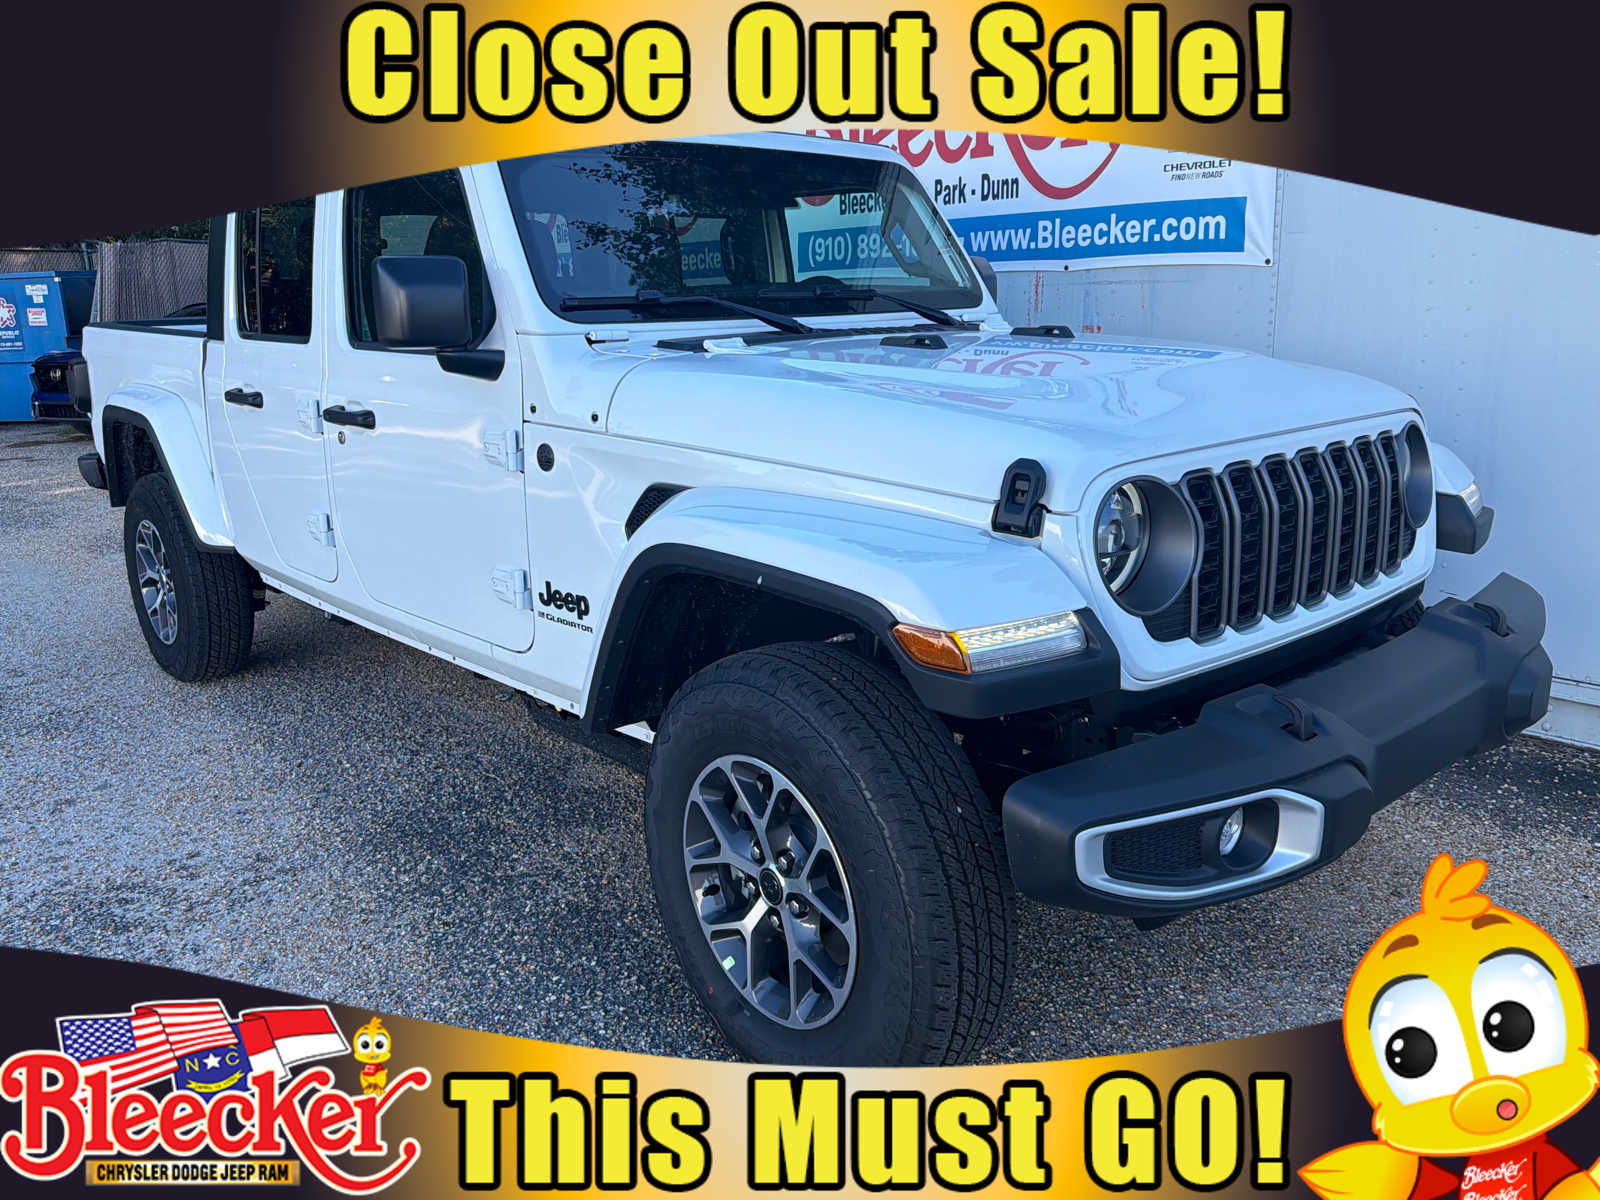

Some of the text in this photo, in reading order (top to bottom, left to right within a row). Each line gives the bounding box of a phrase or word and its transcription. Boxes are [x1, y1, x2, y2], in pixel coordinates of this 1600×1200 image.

[1163, 159, 1232, 173] CHEVROLET
[934, 176, 967, 205] Park
[981, 173, 1019, 202] Dunn
[808, 232, 852, 267] (910)
[970, 213, 1226, 253] www.Bleecker.com
[538, 580, 590, 621] Jeep
[546, 613, 593, 634] GLADIATOR
